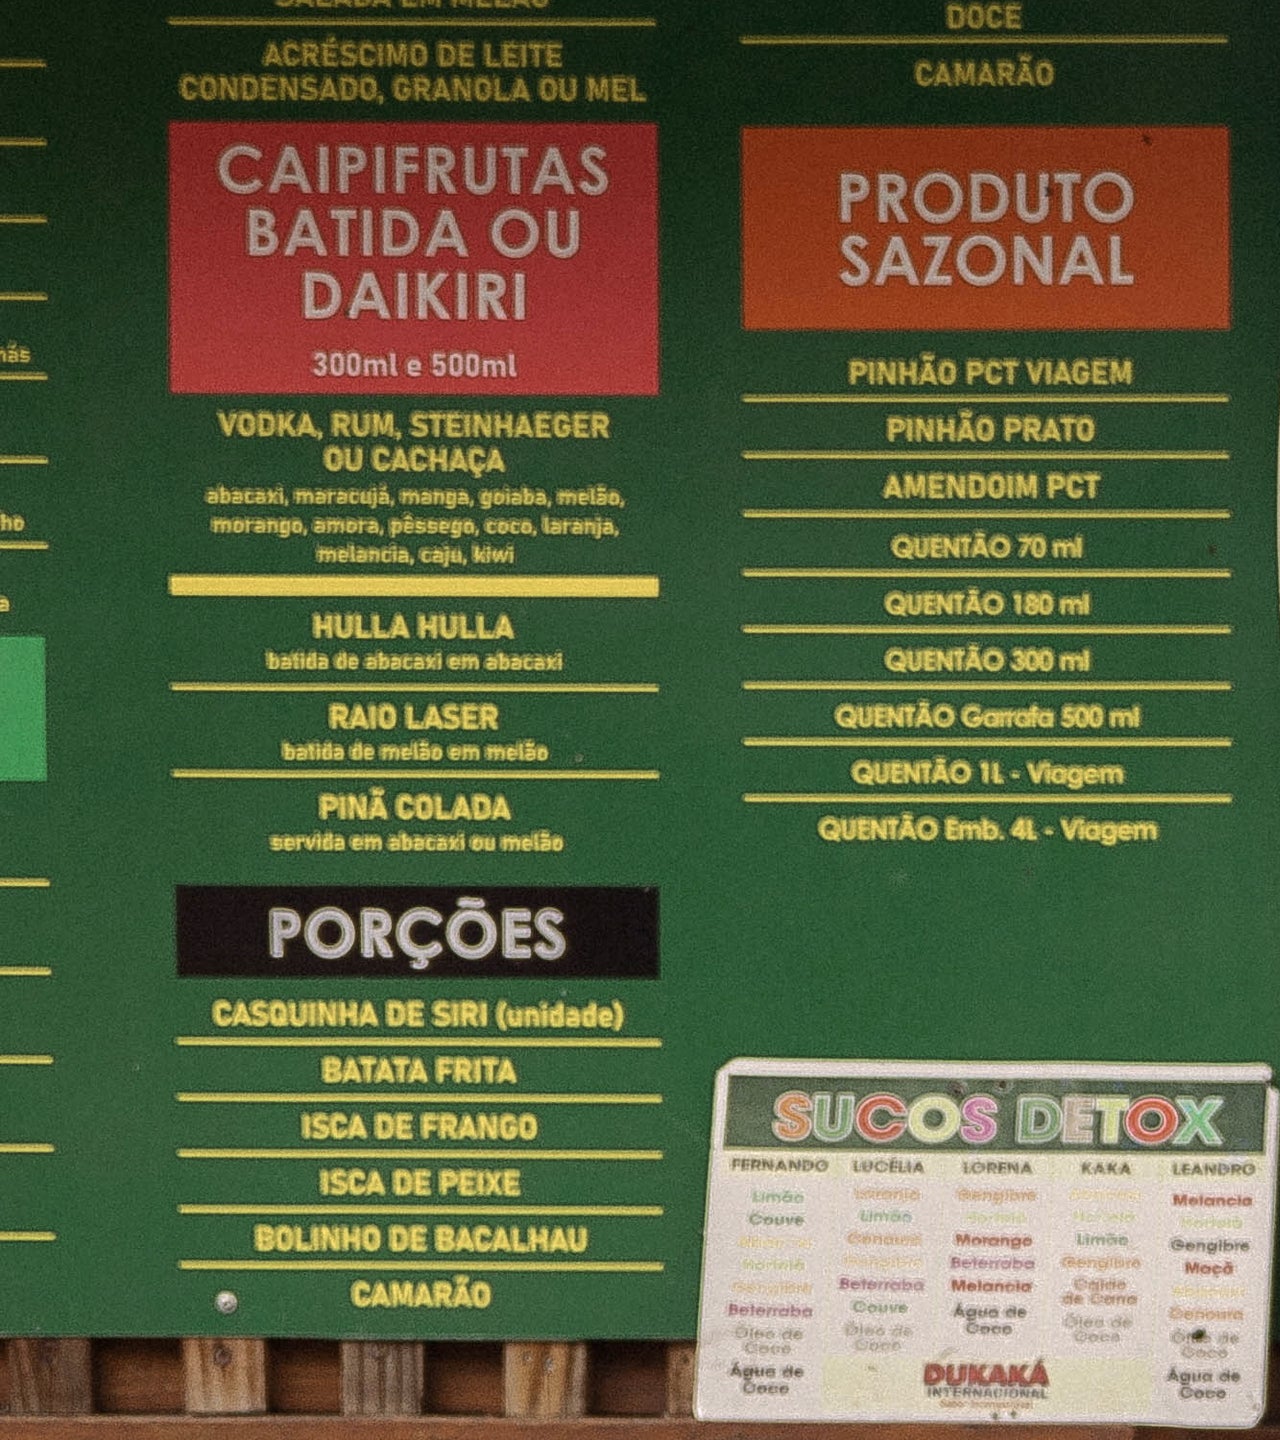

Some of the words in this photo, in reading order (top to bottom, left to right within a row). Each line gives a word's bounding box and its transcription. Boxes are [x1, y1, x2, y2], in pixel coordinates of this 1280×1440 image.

[946, 1, 1022, 30] DOCE
[914, 52, 1055, 87] CAMARÃO
[218, 144, 609, 196] CAIPIFRUTAS
[840, 171, 1134, 224] PRODUTO
[248, 208, 469, 257] BATIDA
[490, 208, 580, 259] OU
[839, 234, 1135, 287] SAZONAL
[303, 271, 525, 320] DAIKIRI
[312, 351, 398, 377] 300ml
[406, 358, 422, 377] e
[431, 352, 517, 378] 500ml
[849, 352, 957, 386] PINHÃO
[966, 359, 1020, 386] PCT
[1025, 358, 1133, 386] VIAGEM
[219, 412, 322, 440] VODKA,
[332, 413, 402, 440] RUM,
[410, 413, 610, 439] STEINHAEGER
[323, 445, 364, 472] OU
[371, 445, 506, 479] CACHAÇA
[205, 485, 289, 507] abacaxi,
[293, 485, 395, 509] maracujá,
[398, 489, 475, 510] manga,
[479, 487, 552, 510] goiaba,
[556, 484, 625, 508] melão,
[312, 613, 411, 639] HULLA
[417, 614, 515, 640] HULLA
[265, 651, 330, 670] batida
[333, 651, 360, 671] de
[363, 651, 443, 671] abacaxi
[446, 653, 480, 671] em
[484, 652, 564, 671] abacaxi
[834, 701, 956, 729] QUENTÃO
[960, 703, 1055, 729] Garrafa
[1060, 704, 1105, 729] 500
[1109, 706, 1141, 728] ml
[318, 787, 389, 820] PINÃ
[394, 793, 512, 821] COLADA
[268, 896, 567, 971] PORÇÕES
[212, 1001, 377, 1029] CASQUINHA
[386, 1002, 424, 1027] DE
[432, 1002, 487, 1028] SIRI
[496, 1002, 624, 1031] (unidade)
[317, 1056, 428, 1083] BATATA
[436, 1057, 516, 1083] FRITA
[771, 1089, 1000, 1144] SUCOS
[1015, 1093, 1224, 1146] DETOX
[731, 1157, 829, 1173] FERNANDO
[852, 1156, 925, 1174] LUCÉLIA
[962, 1161, 1033, 1175] LORENA
[1080, 1161, 1132, 1176] KAKA
[1172, 1162, 1256, 1177] LEANDRO
[751, 1190, 805, 1204] Limão
[1172, 1193, 1253, 1207] Melancia
[749, 1213, 805, 1226] Couve
[955, 1233, 1033, 1250] Morango
[1170, 1238, 1251, 1255] Gengibre
[1184, 1261, 1234, 1278] Maçã
[351, 1275, 492, 1308] CAMARÃO
[838, 1277, 925, 1292] Beterraba
[923, 1357, 1051, 1387] DUKAKÁ
